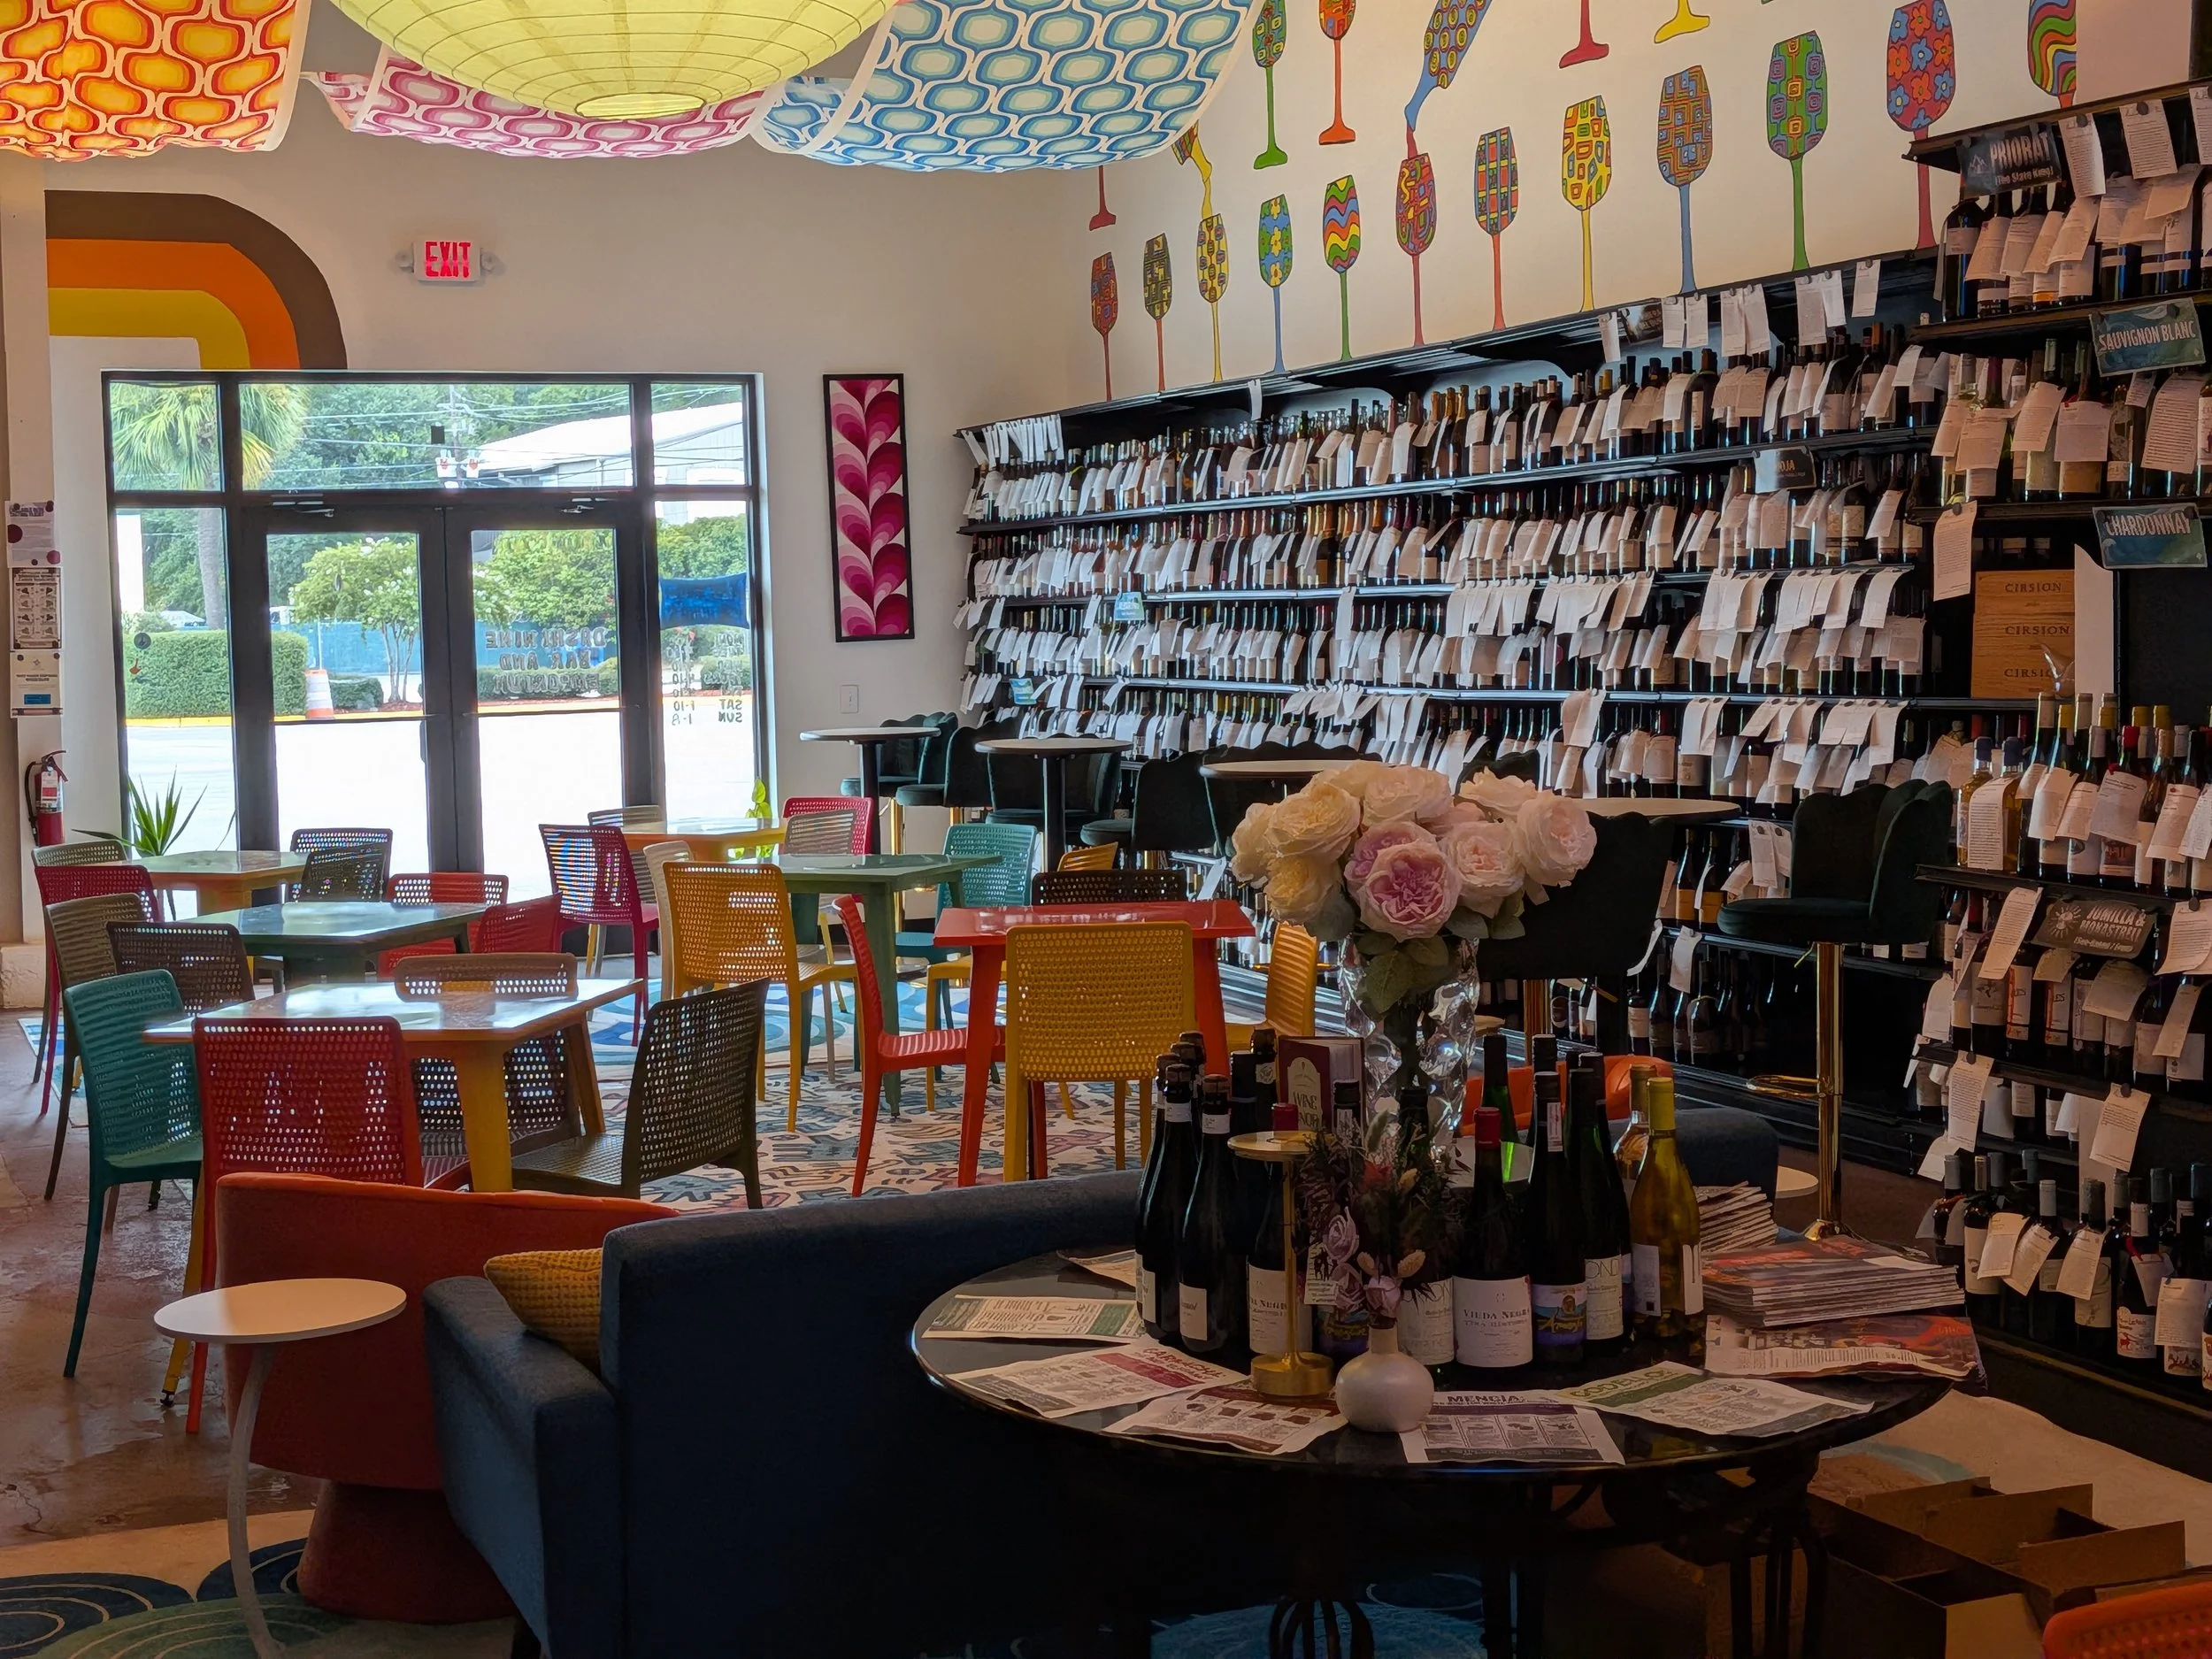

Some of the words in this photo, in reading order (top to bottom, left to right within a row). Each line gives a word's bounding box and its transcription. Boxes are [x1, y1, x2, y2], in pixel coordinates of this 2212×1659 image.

[1990, 132, 2050, 169] PRIORAT
[426, 241, 471, 278] EXIT
[2098, 326, 2161, 351] SAUVIGNON
[2161, 321, 2196, 342] BLANC
[2004, 582, 2062, 593] CIRSION
[2004, 626, 2070, 635] CIRSION
[2087, 904, 2136, 926] JUMILLA
[2135, 909, 2147, 926] &
